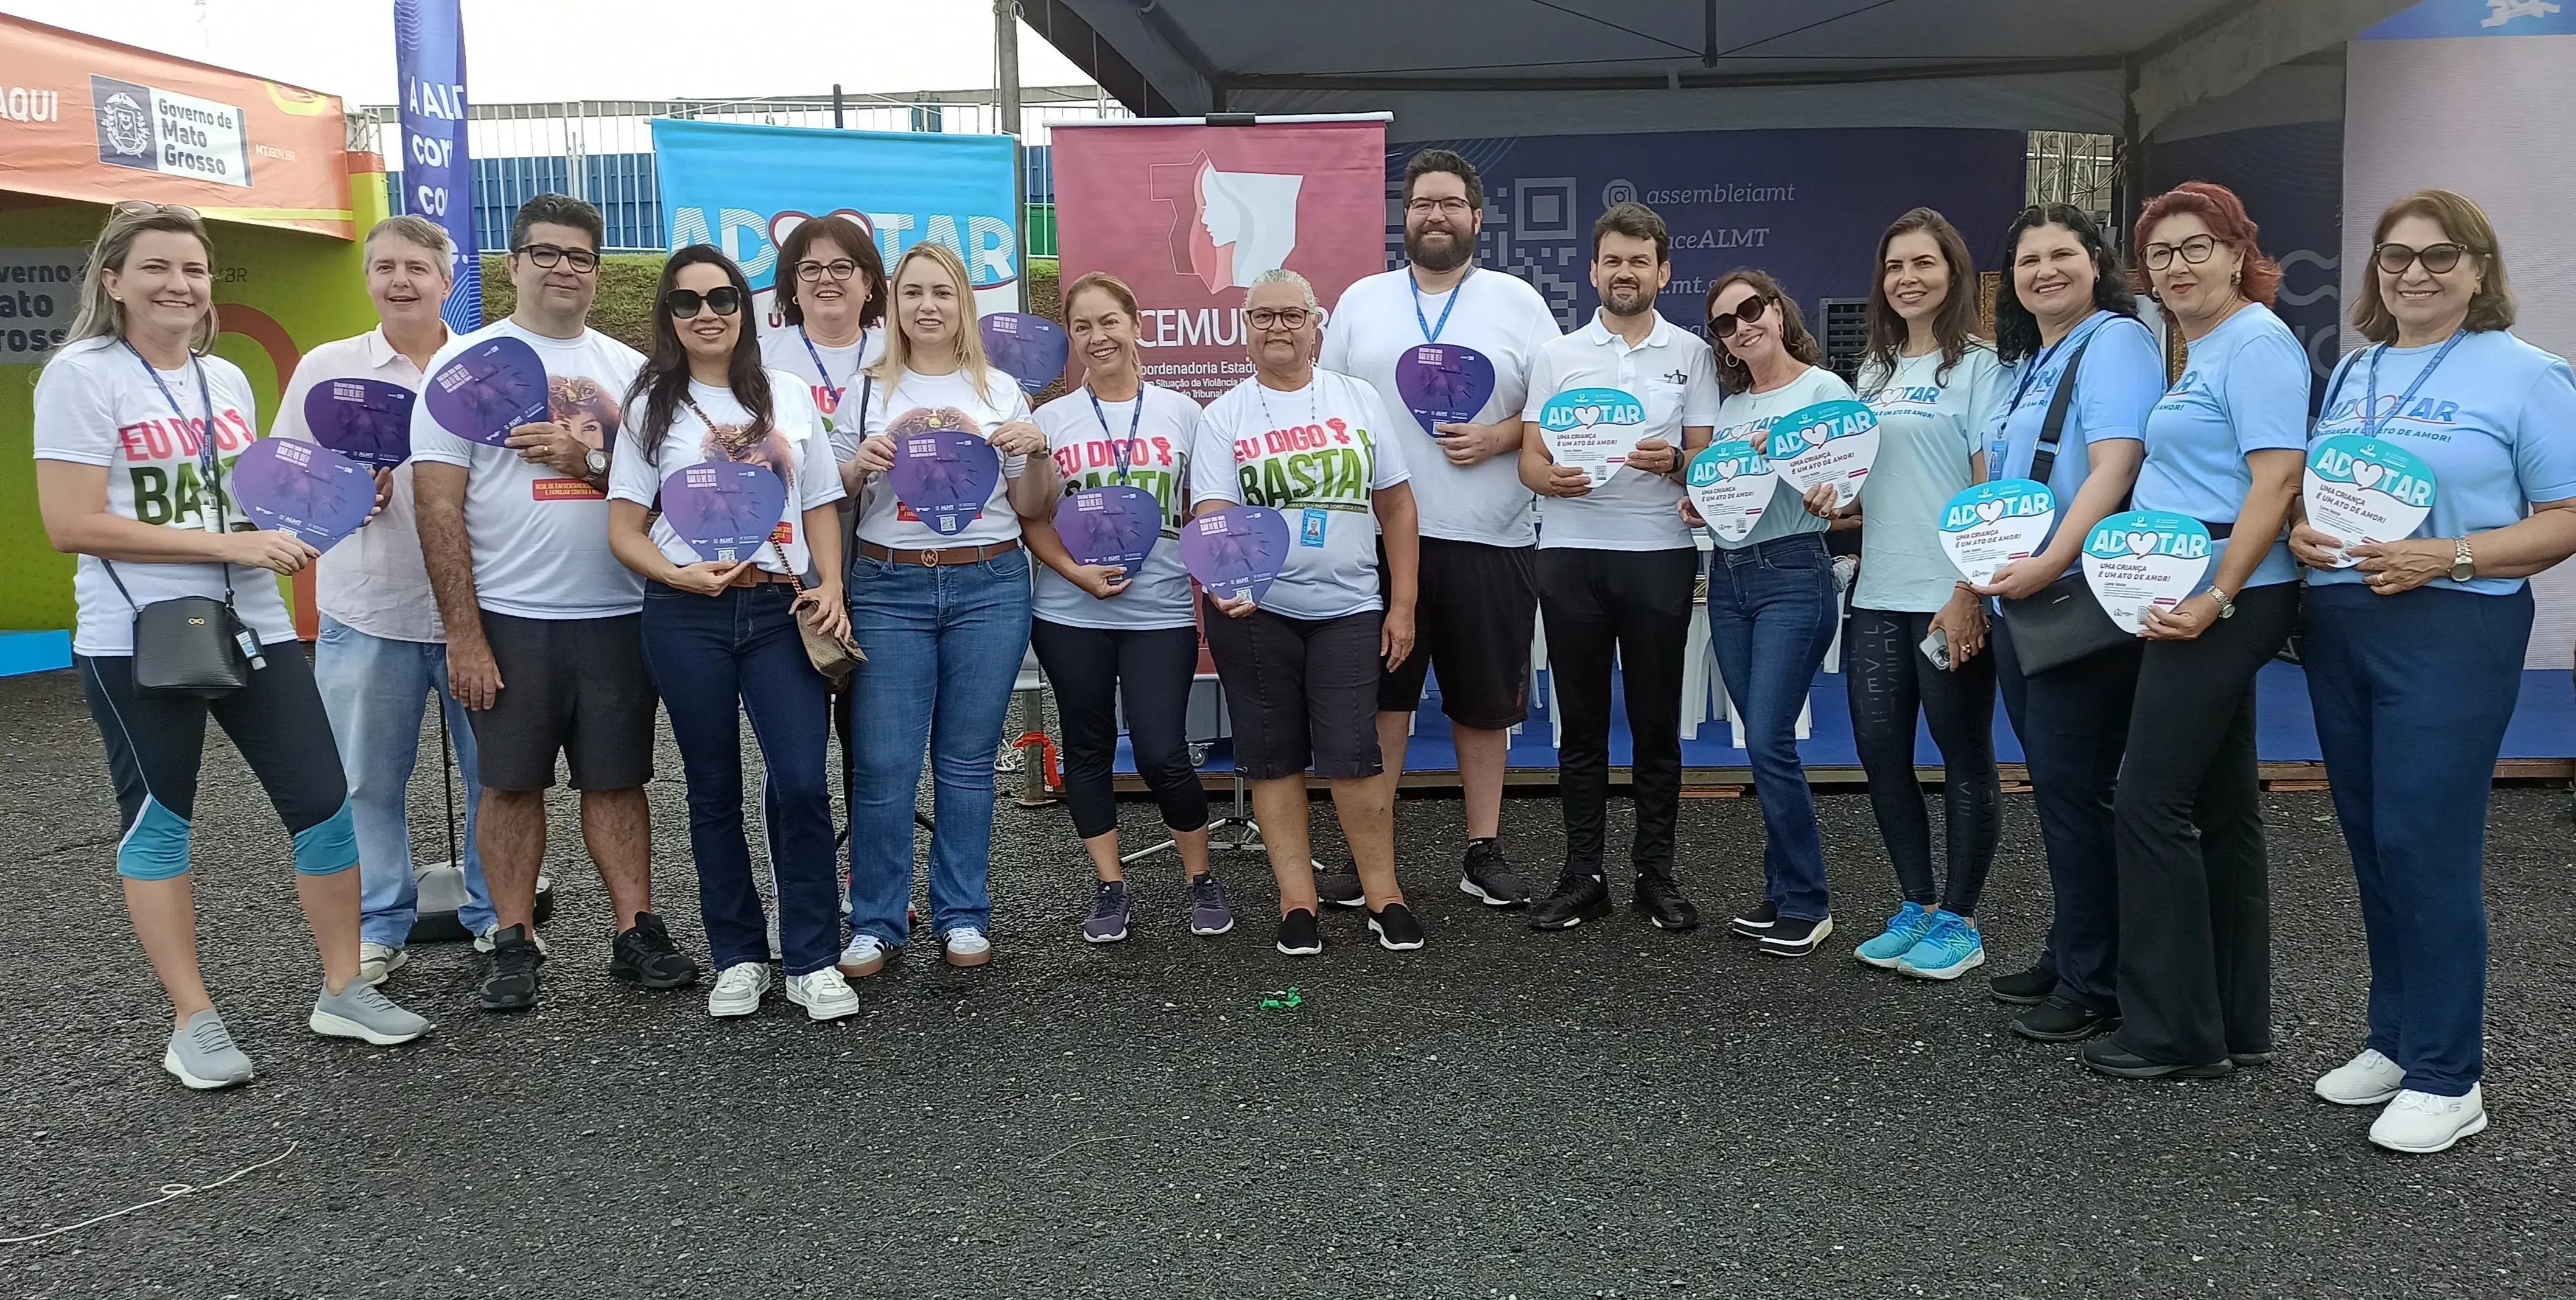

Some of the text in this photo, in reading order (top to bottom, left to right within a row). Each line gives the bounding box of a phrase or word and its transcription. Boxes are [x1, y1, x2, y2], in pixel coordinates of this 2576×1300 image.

[410, 76, 420, 115] A
[159, 99, 232, 130] Governo de
[161, 118, 208, 148] Mato
[164, 144, 225, 175] Grosso
[1646, 183, 1795, 204] assembleiamt
[1667, 228, 1770, 250] ceALMT
[0, 264, 71, 283] verno
[0, 289, 54, 318] ato
[1141, 361, 1258, 375] oordenadoria Estadu
[1156, 378, 1189, 389] Situação
[1191, 379, 1201, 387] de
[1202, 377, 1238, 387] Violência
[1191, 389, 1223, 398] Tribunal
[1912, 410, 1935, 419] AMOR!
[119, 420, 173, 461] EU
[1265, 425, 1327, 454] DIGO
[2414, 430, 2451, 443] AMOR!
[1805, 451, 1831, 463] CRIANÇA
[1808, 462, 1821, 470] ATO
[1833, 452, 1855, 463] AMOR!
[1240, 430, 1374, 507] BASTA!
[2320, 484, 2365, 506] UMA CRIANÇA
[2322, 494, 2334, 503] UM
[2334, 499, 2348, 509] ATO
[2350, 505, 2360, 514] DE
[2360, 509, 2387, 524] AMOR!
[1971, 529, 1999, 539] CRIANÇA
[1998, 533, 2021, 542] AMOR!
[2116, 564, 2147, 573] CRIANÇA
